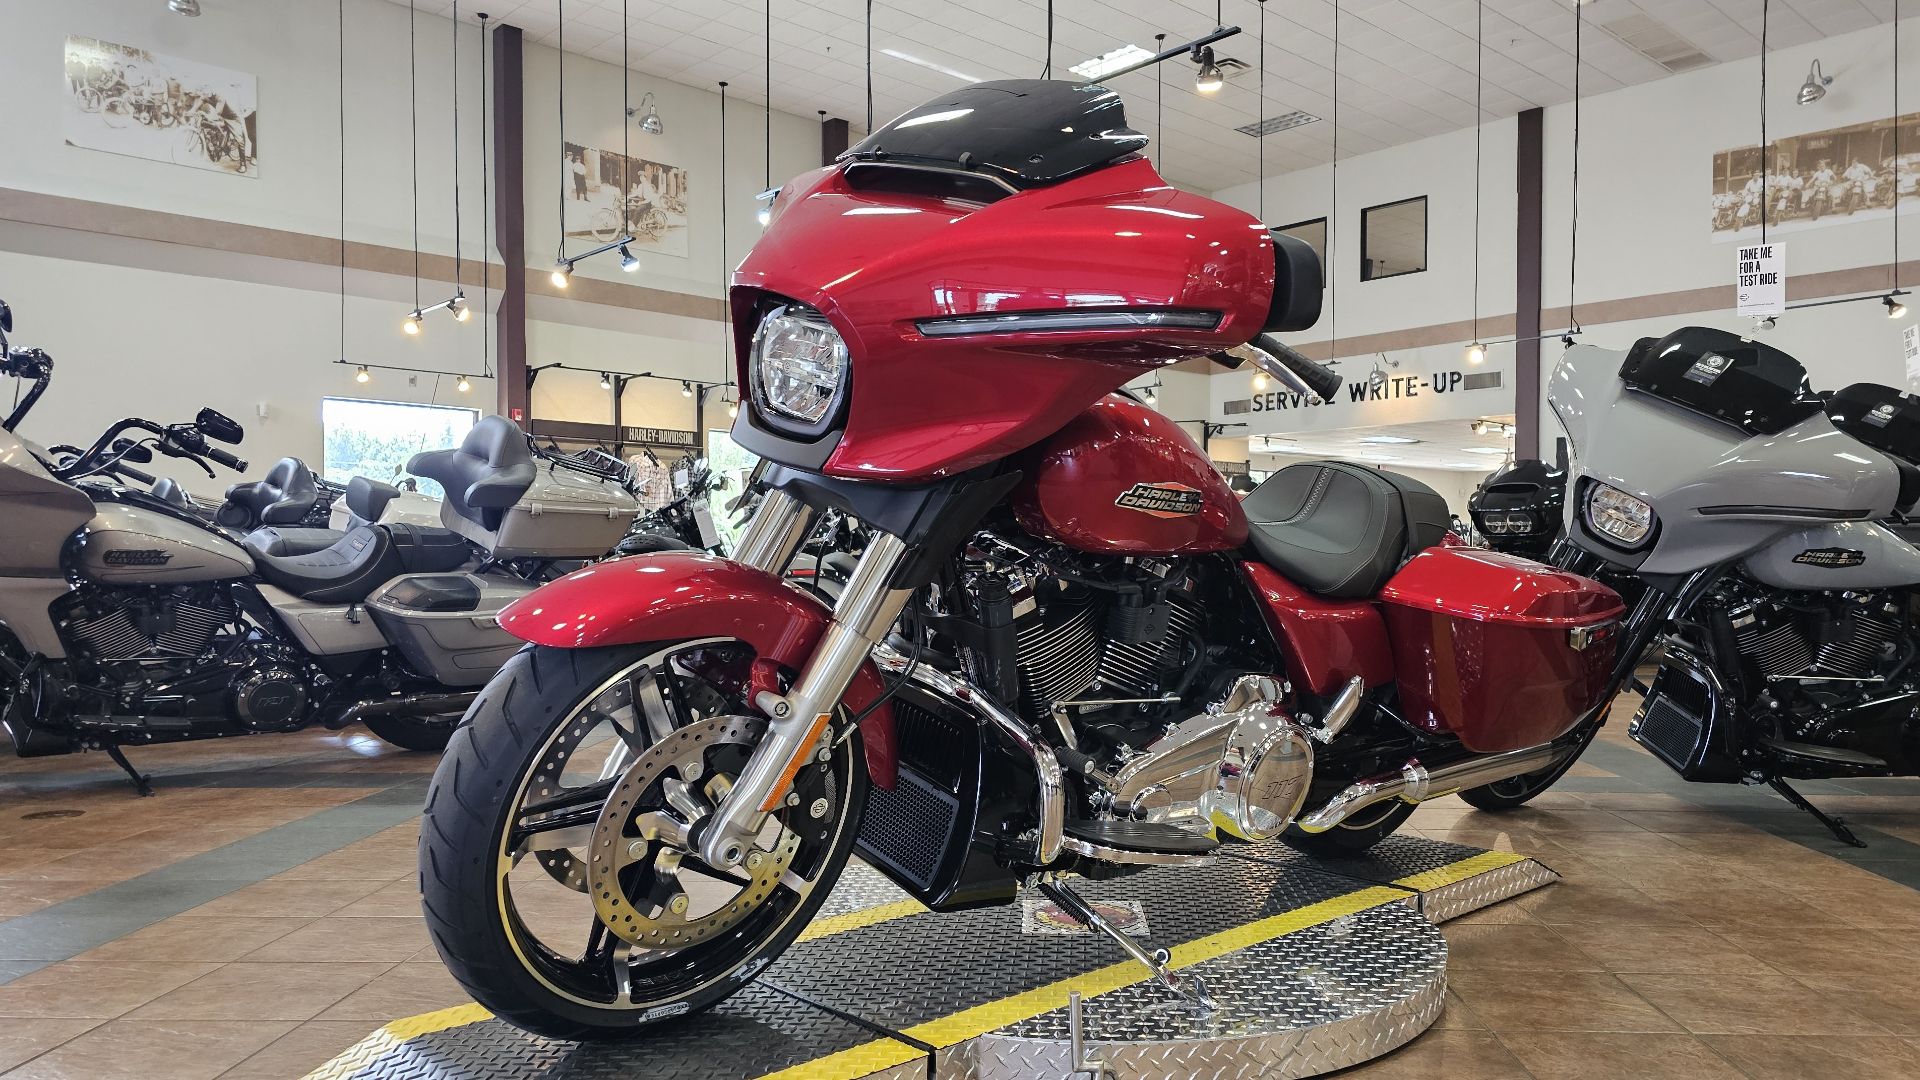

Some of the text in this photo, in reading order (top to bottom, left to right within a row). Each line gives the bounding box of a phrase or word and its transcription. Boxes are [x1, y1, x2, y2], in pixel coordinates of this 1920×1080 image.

[1740, 246, 1772, 260] TAKE ME
[1740, 261, 1760, 274] FOR A
[1740, 272, 1777, 287] TEST RIDE
[1253, 371, 1463, 412] SERVI WRITE-UP
[629, 428, 693, 444] HARLEY-DAVIDSON
[1121, 496, 1200, 512] DAVIDSON
